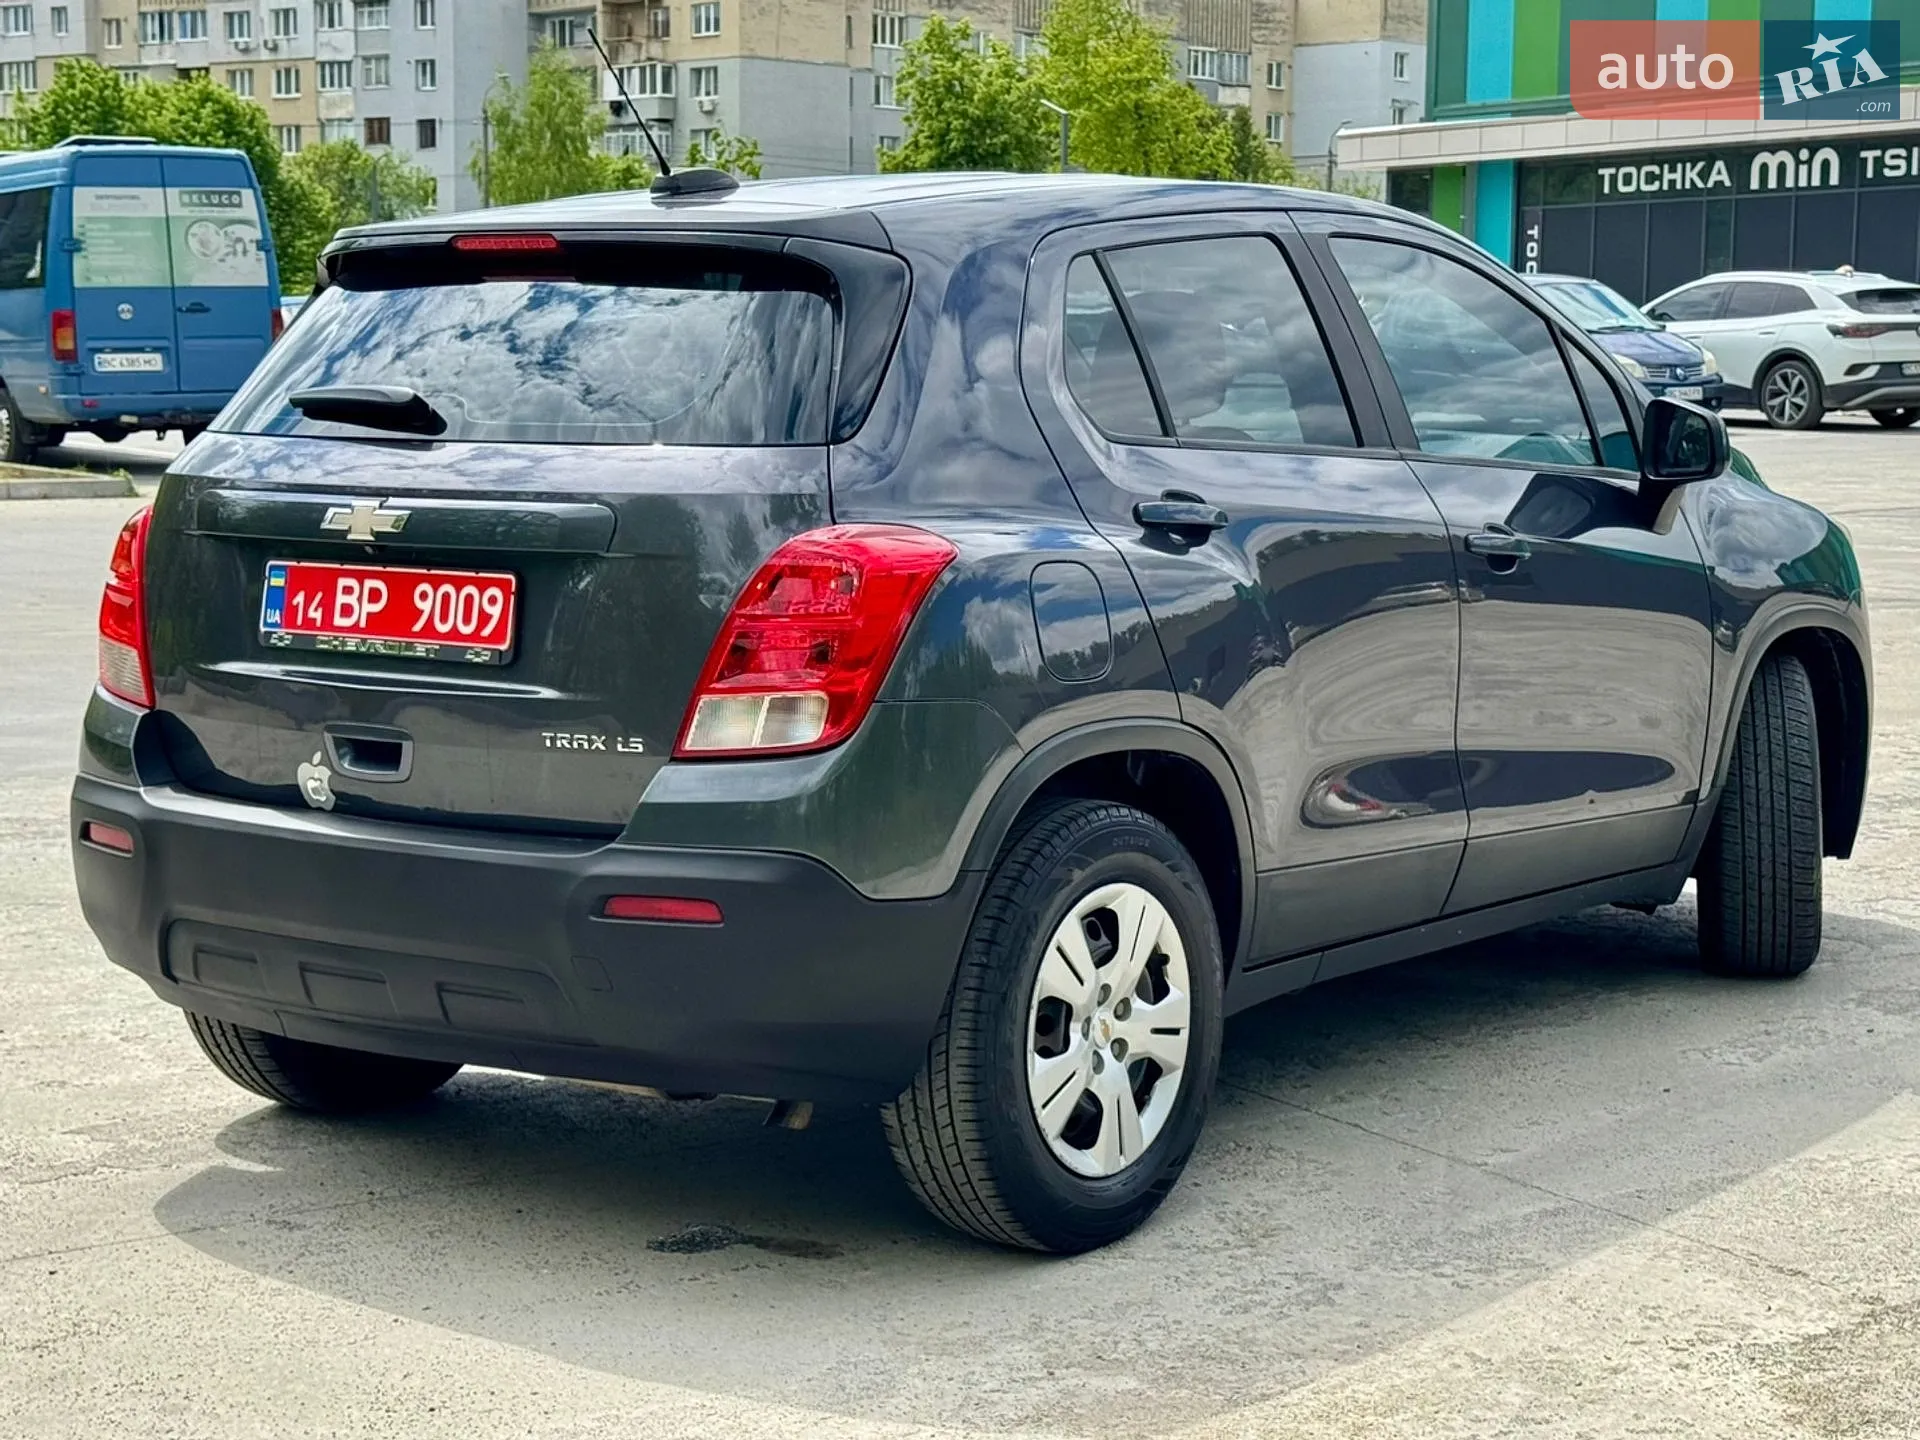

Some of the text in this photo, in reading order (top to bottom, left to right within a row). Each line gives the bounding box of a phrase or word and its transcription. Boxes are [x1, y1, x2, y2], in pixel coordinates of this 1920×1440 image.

[1598, 146, 1919, 195] TOCHKA min TSI
[266, 608, 281, 624] UA
[292, 577, 504, 638] 14 BP 9009
[315, 636, 440, 658] CHEVROLET
[541, 732, 644, 753] TRAX LS
